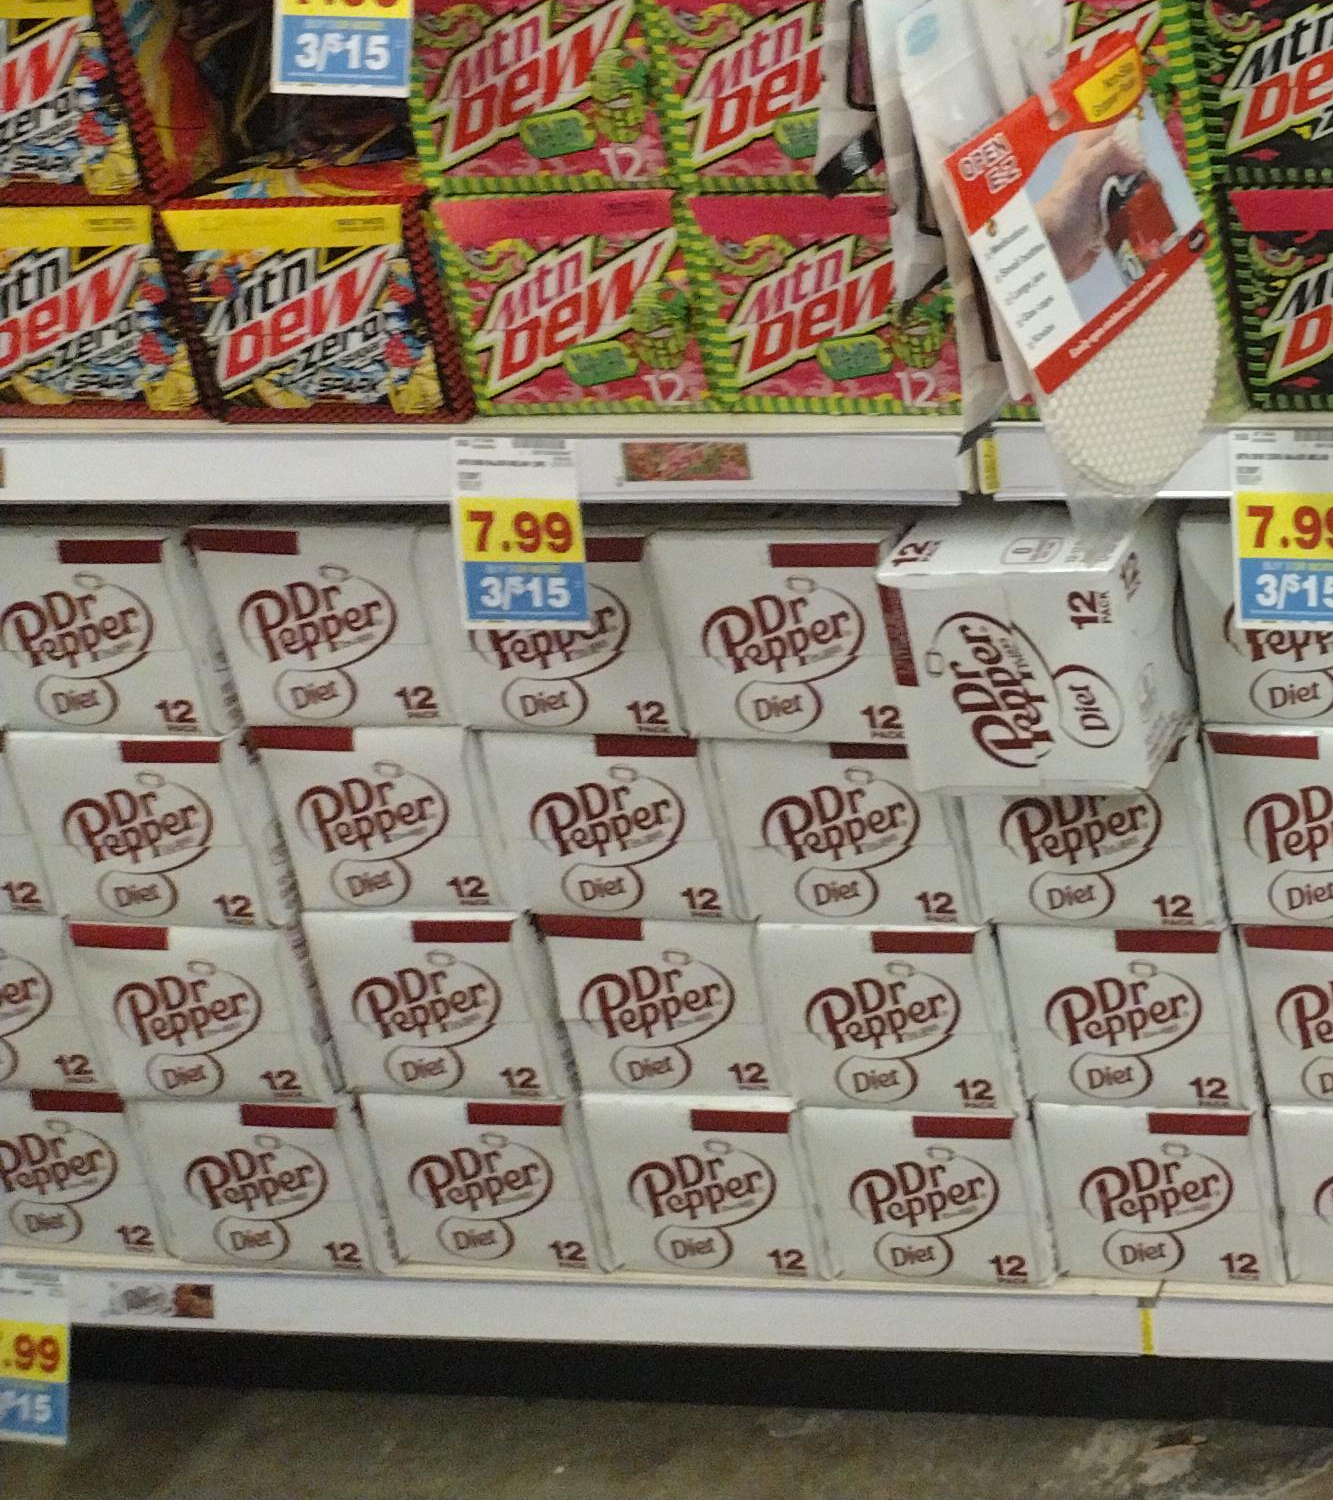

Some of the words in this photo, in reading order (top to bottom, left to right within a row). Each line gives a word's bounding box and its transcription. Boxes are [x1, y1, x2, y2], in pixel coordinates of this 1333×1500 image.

[467, 512, 574, 554] 7.99
[292, 582, 341, 620] Dr
[1067, 591, 1100, 630] 12
[243, 592, 381, 662] Pepper
[291, 680, 340, 706] Diet
[398, 686, 436, 710] 12
[950, 660, 1001, 714] Dr
[958, 624, 1054, 751] Pepper
[1068, 684, 1110, 732] Diet
[678, 1153, 720, 1190] Dr
[631, 1162, 764, 1225] Pepper
[671, 1237, 714, 1260] Diet
